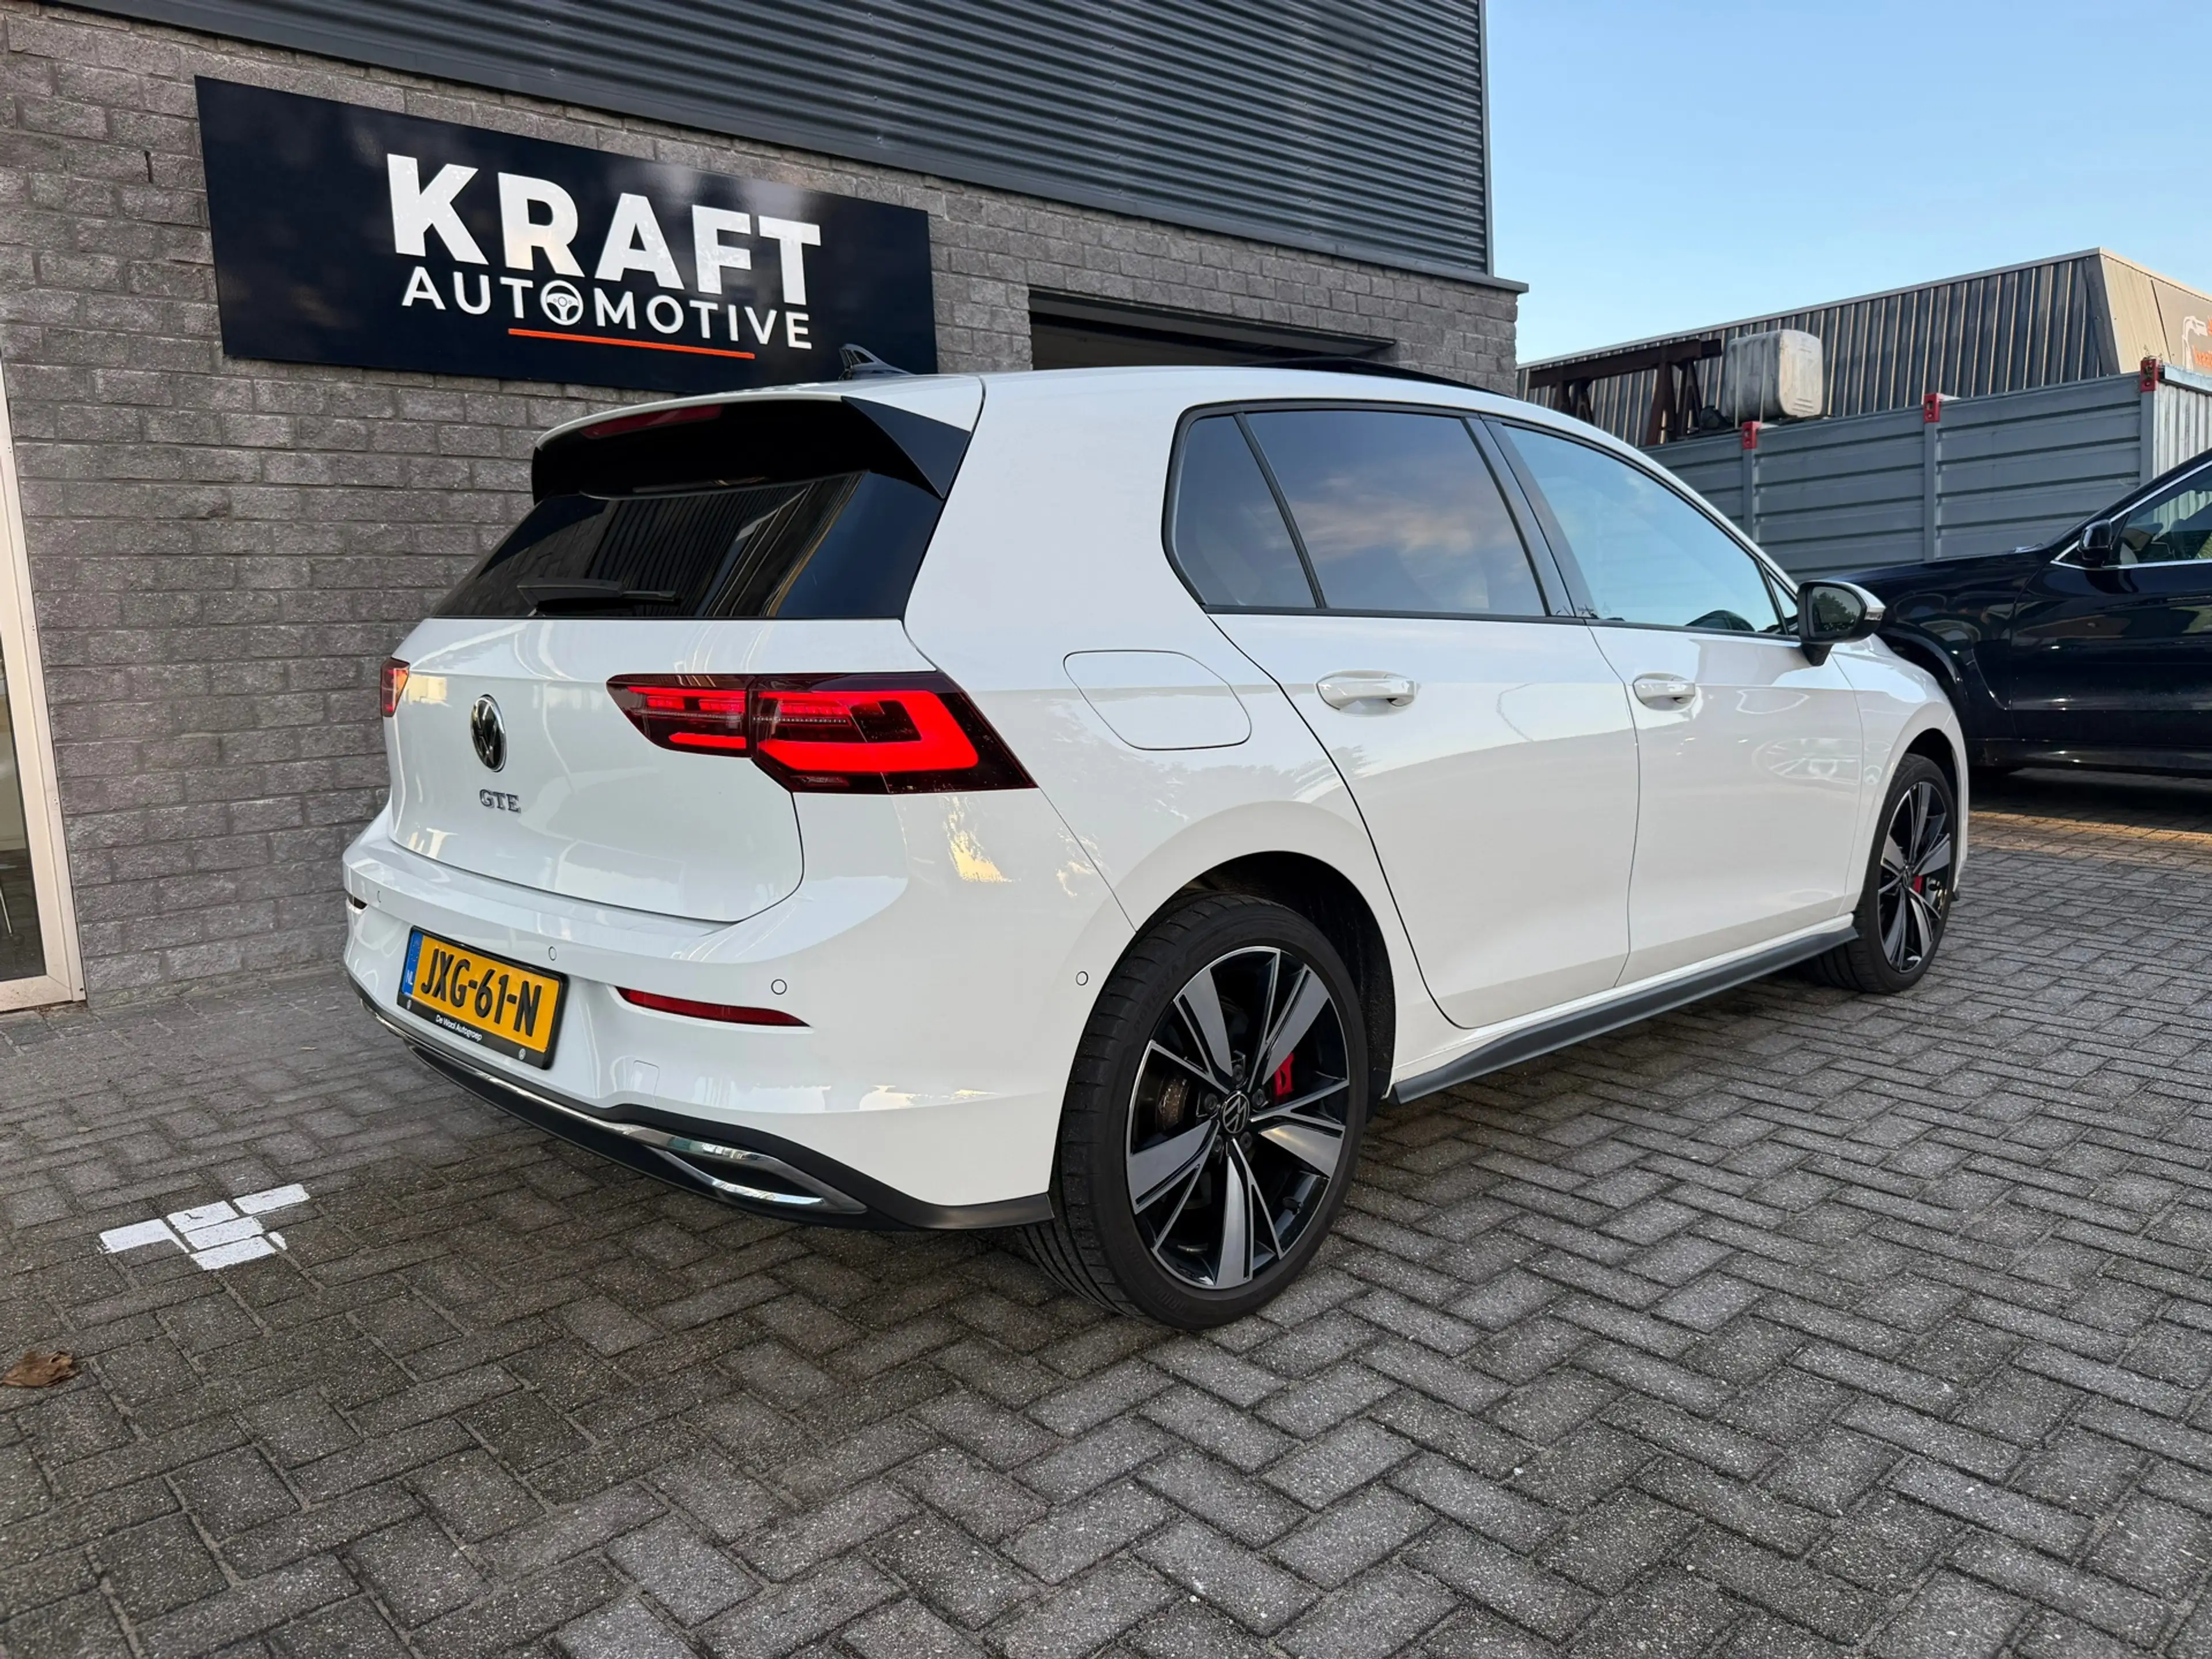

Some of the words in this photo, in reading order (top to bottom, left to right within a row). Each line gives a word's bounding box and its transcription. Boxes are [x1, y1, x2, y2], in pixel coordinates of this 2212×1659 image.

[387, 153, 821, 305] KRAFT
[402, 266, 813, 350] AUTOMOTIVE
[479, 789, 521, 813] GTE
[405, 969, 414, 986] NL
[421, 948, 542, 1037] JXG-61-N
